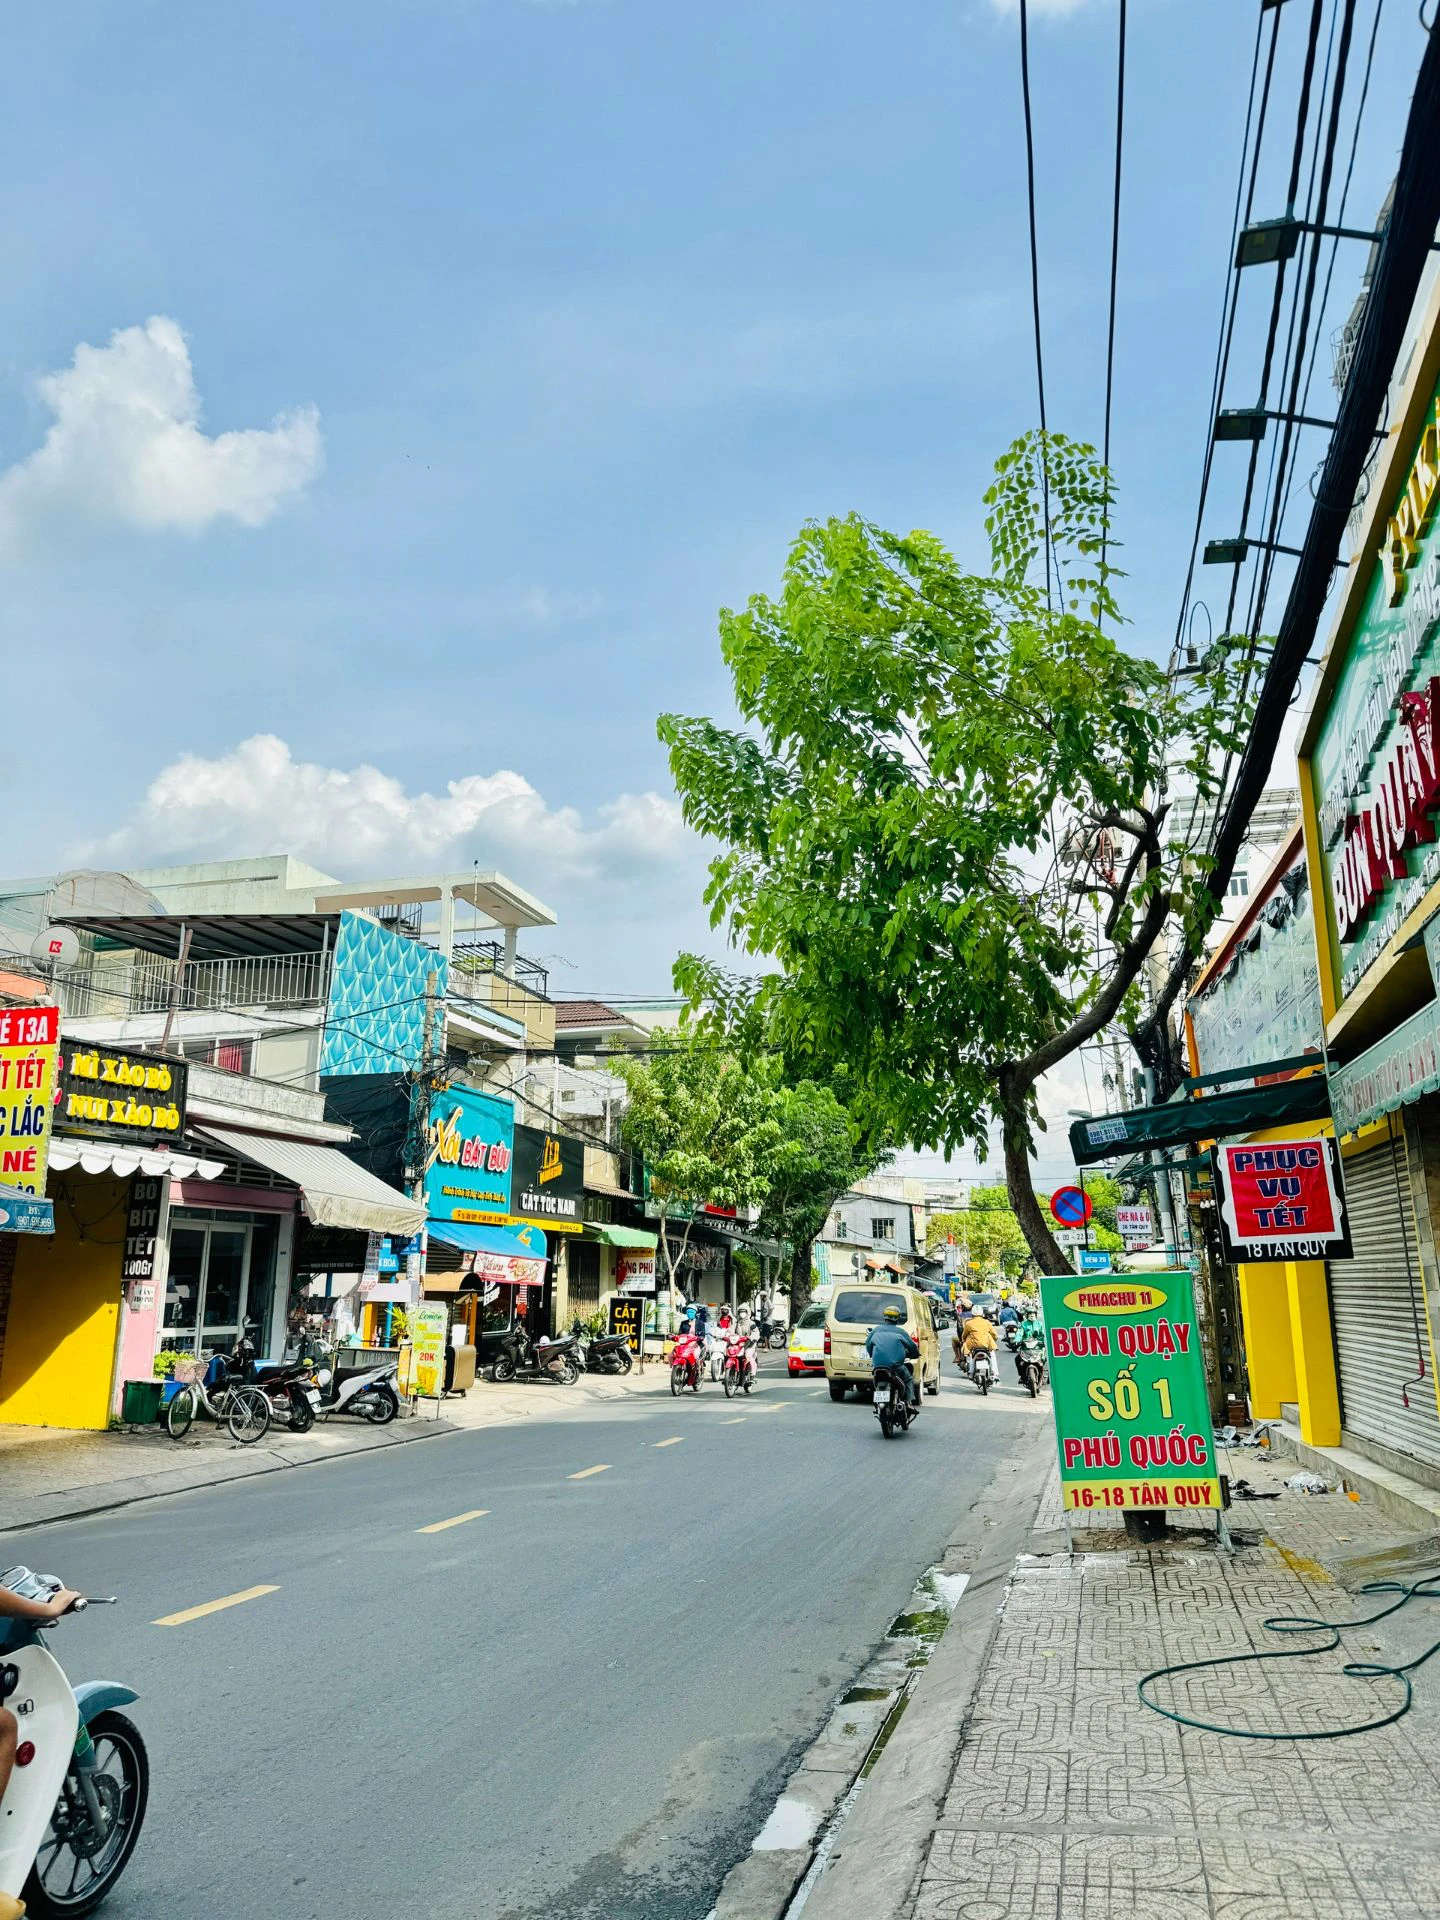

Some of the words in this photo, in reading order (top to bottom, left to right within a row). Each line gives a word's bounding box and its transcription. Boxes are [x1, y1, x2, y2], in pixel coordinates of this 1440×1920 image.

[17, 1015, 49, 1043] 13A
[16, 1048, 46, 1089] TẾT
[70, 1050, 100, 1079] MÌ
[100, 1056, 146, 1087] XÀO
[143, 1064, 172, 1092] BÒ
[10, 1094, 45, 1136] LẮC
[66, 1093, 109, 1121] NUI
[108, 1096, 153, 1127] XÀO
[152, 1102, 180, 1131] BÒ
[2, 1145, 37, 1173] NÉ
[462, 1136, 487, 1168] BÁT
[1233, 1147, 1320, 1173] PHỤC
[134, 1179, 158, 1200] BÒ
[521, 1184, 540, 1211] CẮT
[556, 1197, 576, 1216] NAM
[1256, 1176, 1302, 1200] VỤ
[129, 1206, 158, 1228] BÍT
[1252, 1199, 1309, 1229] TẾT
[126, 1232, 156, 1256] TẾT
[1246, 1243, 1263, 1258] 18
[638, 1259, 653, 1274] PHÚ
[614, 1302, 638, 1319] CẮT
[1078, 1291, 1138, 1307] PIKACHU
[1139, 1290, 1153, 1306] 11
[614, 1320, 637, 1336] TÓC
[1050, 1321, 1111, 1358] BÚN
[1117, 1318, 1191, 1361] QUẬY
[419, 1352, 435, 1362] 20K
[1086, 1362, 1142, 1422] SỐ
[1151, 1377, 1174, 1420] 1
[1063, 1430, 1121, 1469] PHÚ
[1129, 1423, 1208, 1471] QUỐC
[1070, 1485, 1125, 1509] 16-18
[1129, 1482, 1169, 1507] TÂN
[1174, 1481, 1212, 1509] QUÝ
